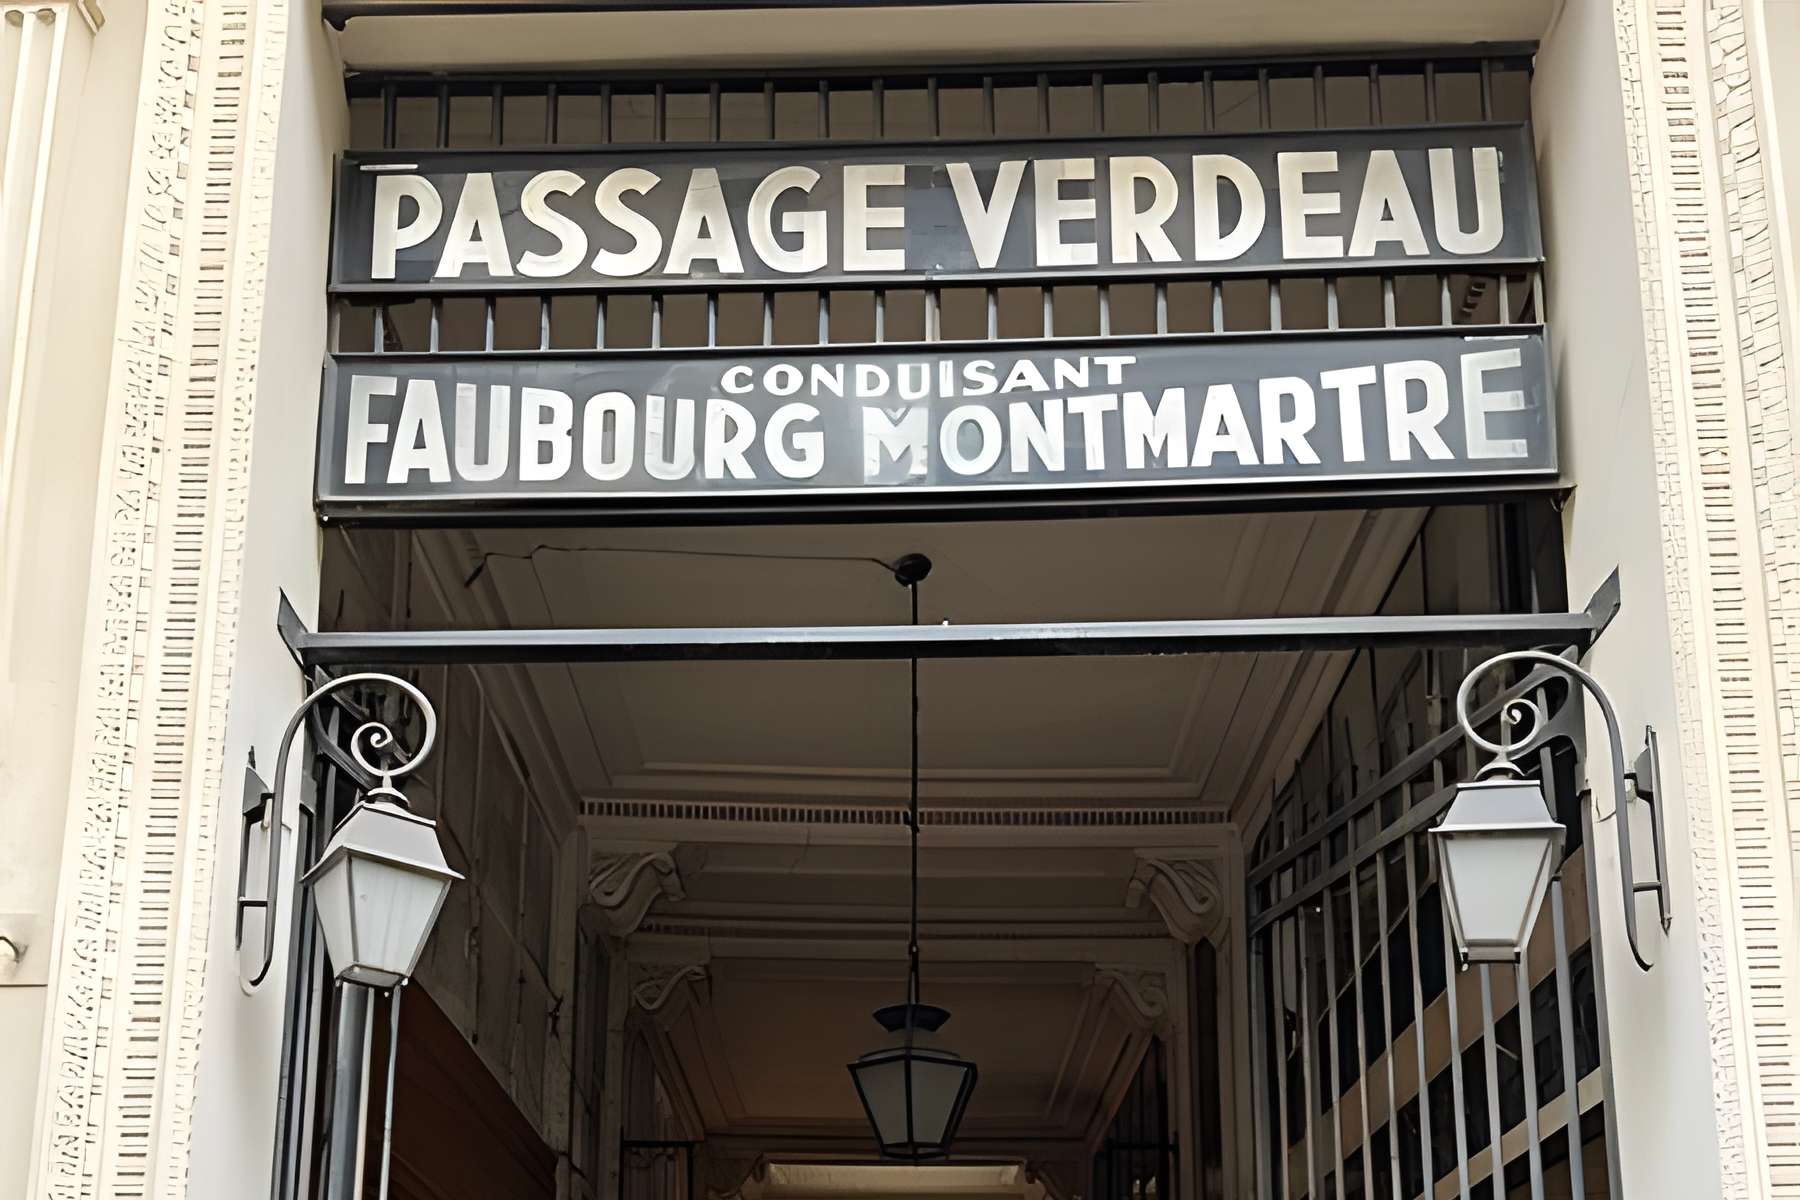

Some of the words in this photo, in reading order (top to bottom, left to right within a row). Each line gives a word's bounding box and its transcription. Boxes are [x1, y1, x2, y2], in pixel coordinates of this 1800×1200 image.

[371, 164, 905, 280] PASSAGE
[946, 146, 1505, 269] VERDEAU
[344, 374, 826, 485] FAUBOURG
[862, 347, 1529, 486] MONTMARTRE
[720, 355, 1136, 400] CONDUISANT
